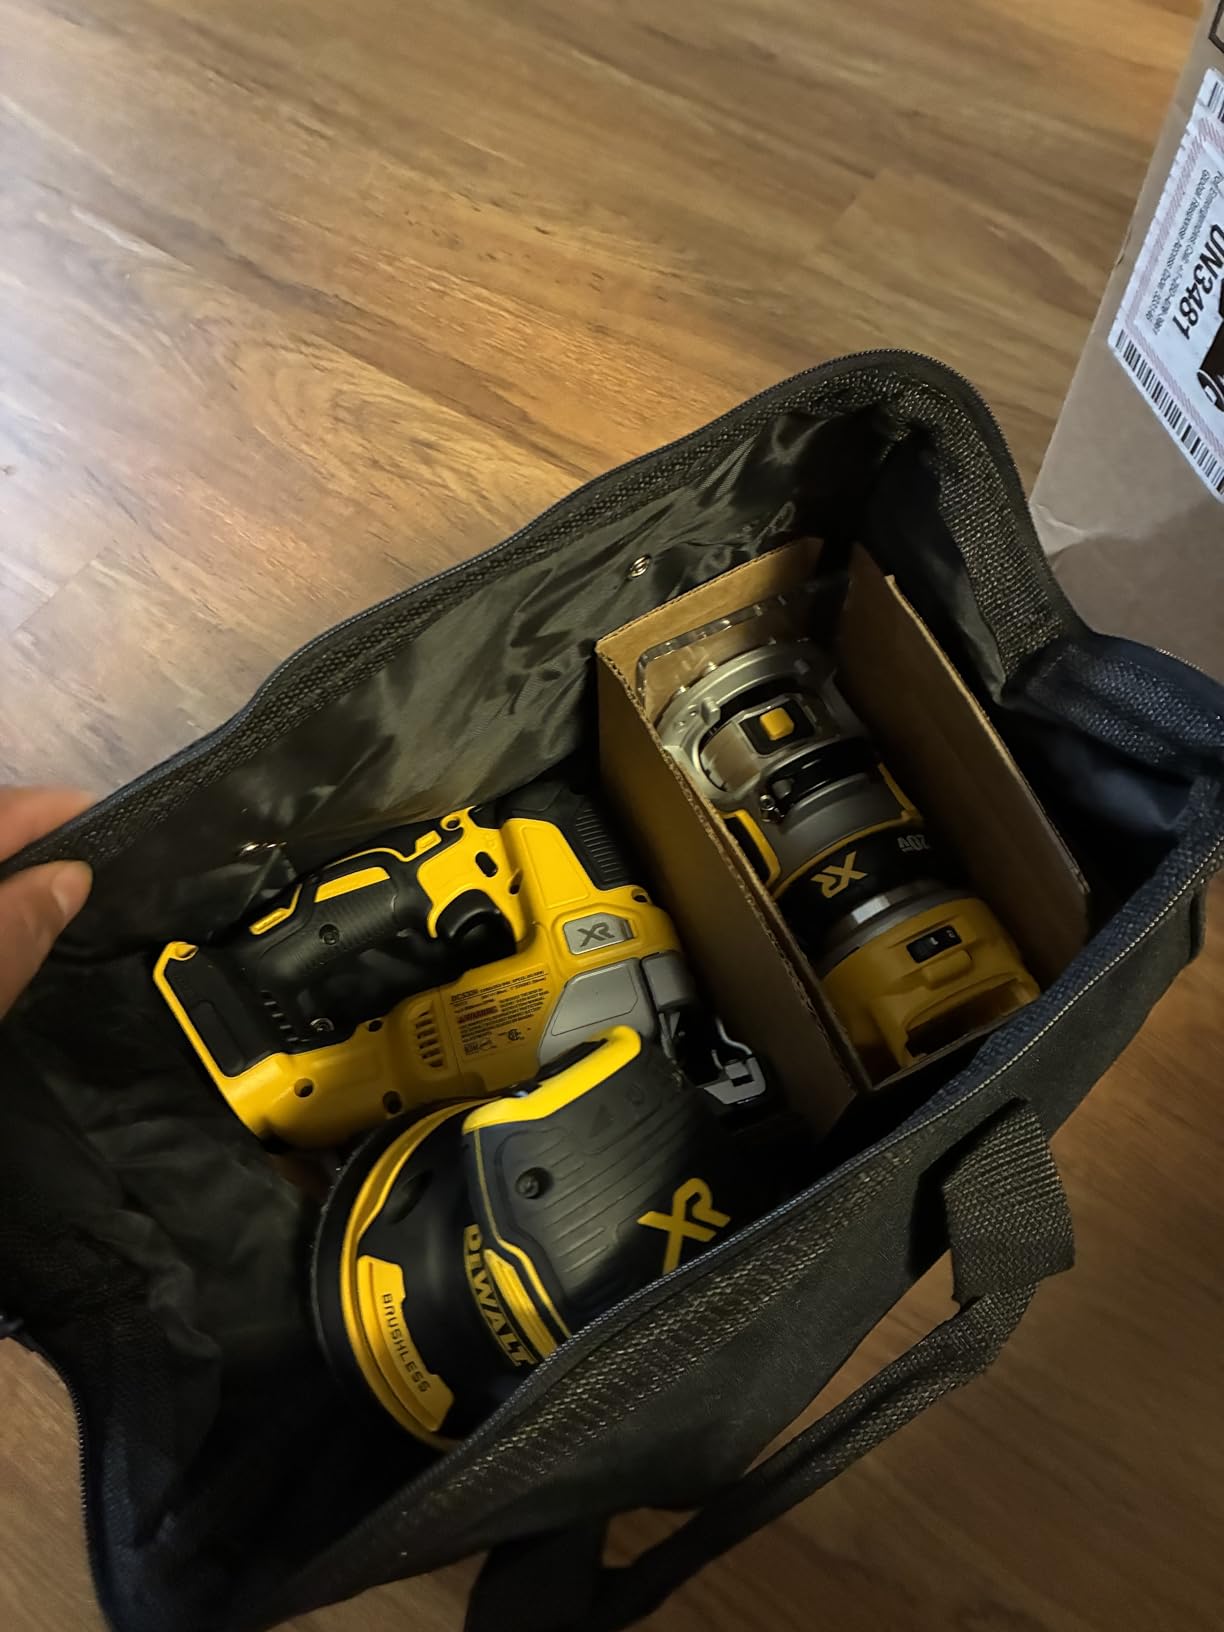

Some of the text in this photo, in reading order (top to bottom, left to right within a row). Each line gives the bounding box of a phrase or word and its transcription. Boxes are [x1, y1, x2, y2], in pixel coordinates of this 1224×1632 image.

[1172, 224, 1224, 341] UN3481
[810, 851, 868, 899] XR
[577, 921, 616, 948] XR
[636, 1177, 731, 1274] XR
[382, 1293, 432, 1393] BRUSHLESS
